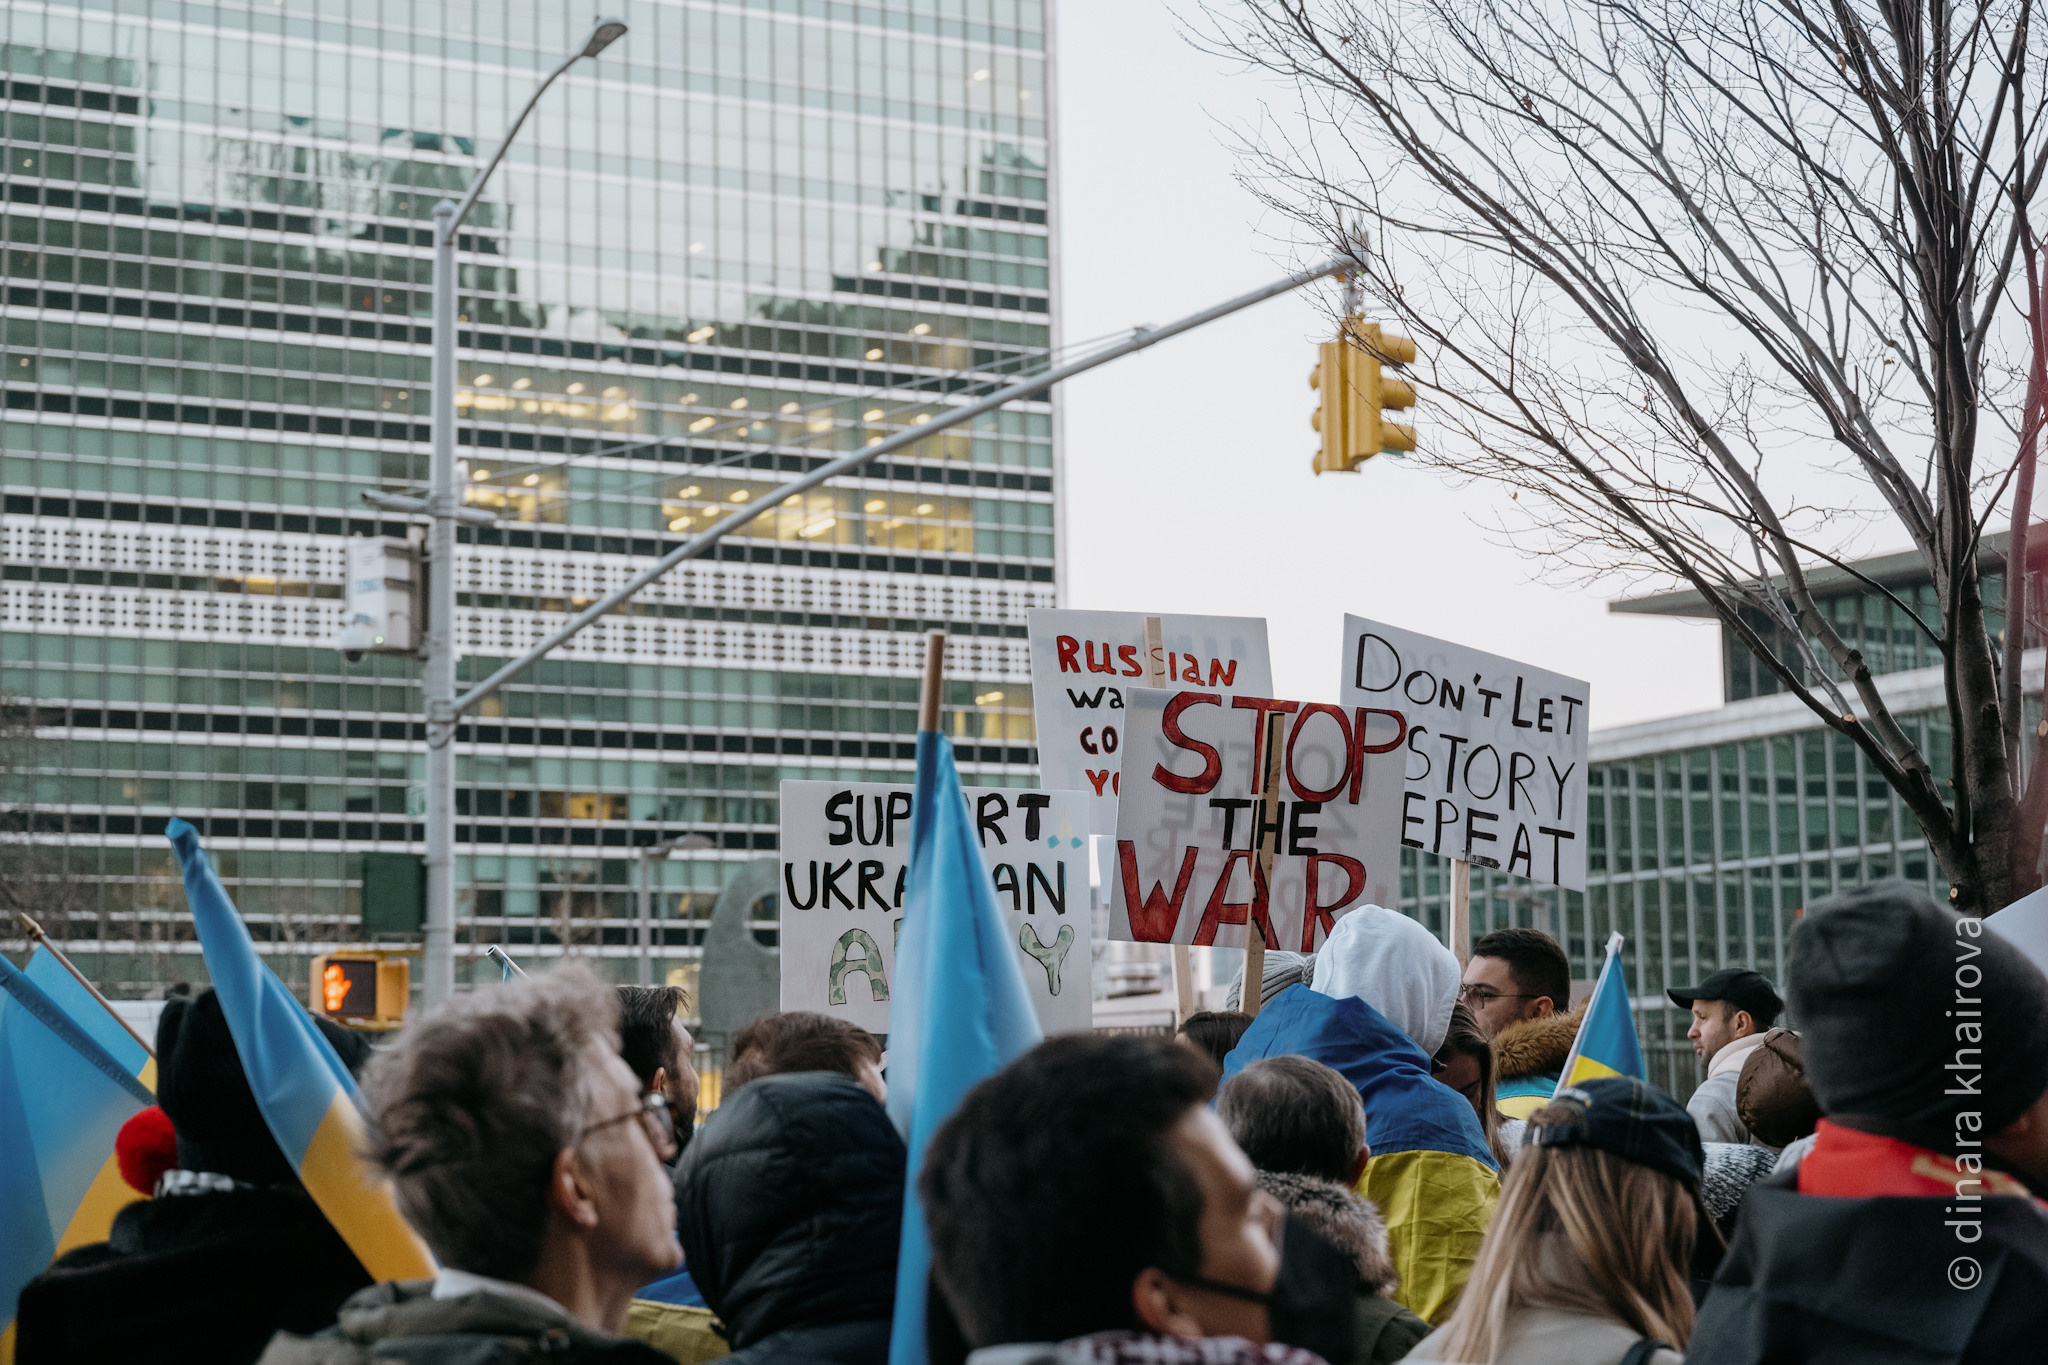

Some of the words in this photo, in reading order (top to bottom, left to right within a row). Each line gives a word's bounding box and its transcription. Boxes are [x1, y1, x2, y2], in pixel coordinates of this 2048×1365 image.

[1355, 633, 1502, 718] DON'T
[1512, 676, 1583, 735] LET
[1152, 690, 1408, 804] STOP
[1405, 725, 1576, 820] STORY
[825, 790, 1051, 848] SUPRT
[1209, 798, 1322, 856] THE
[1401, 791, 1576, 886] EPEAT
[1117, 839, 1367, 953] WAR
[828, 917, 1075, 1006] AY
